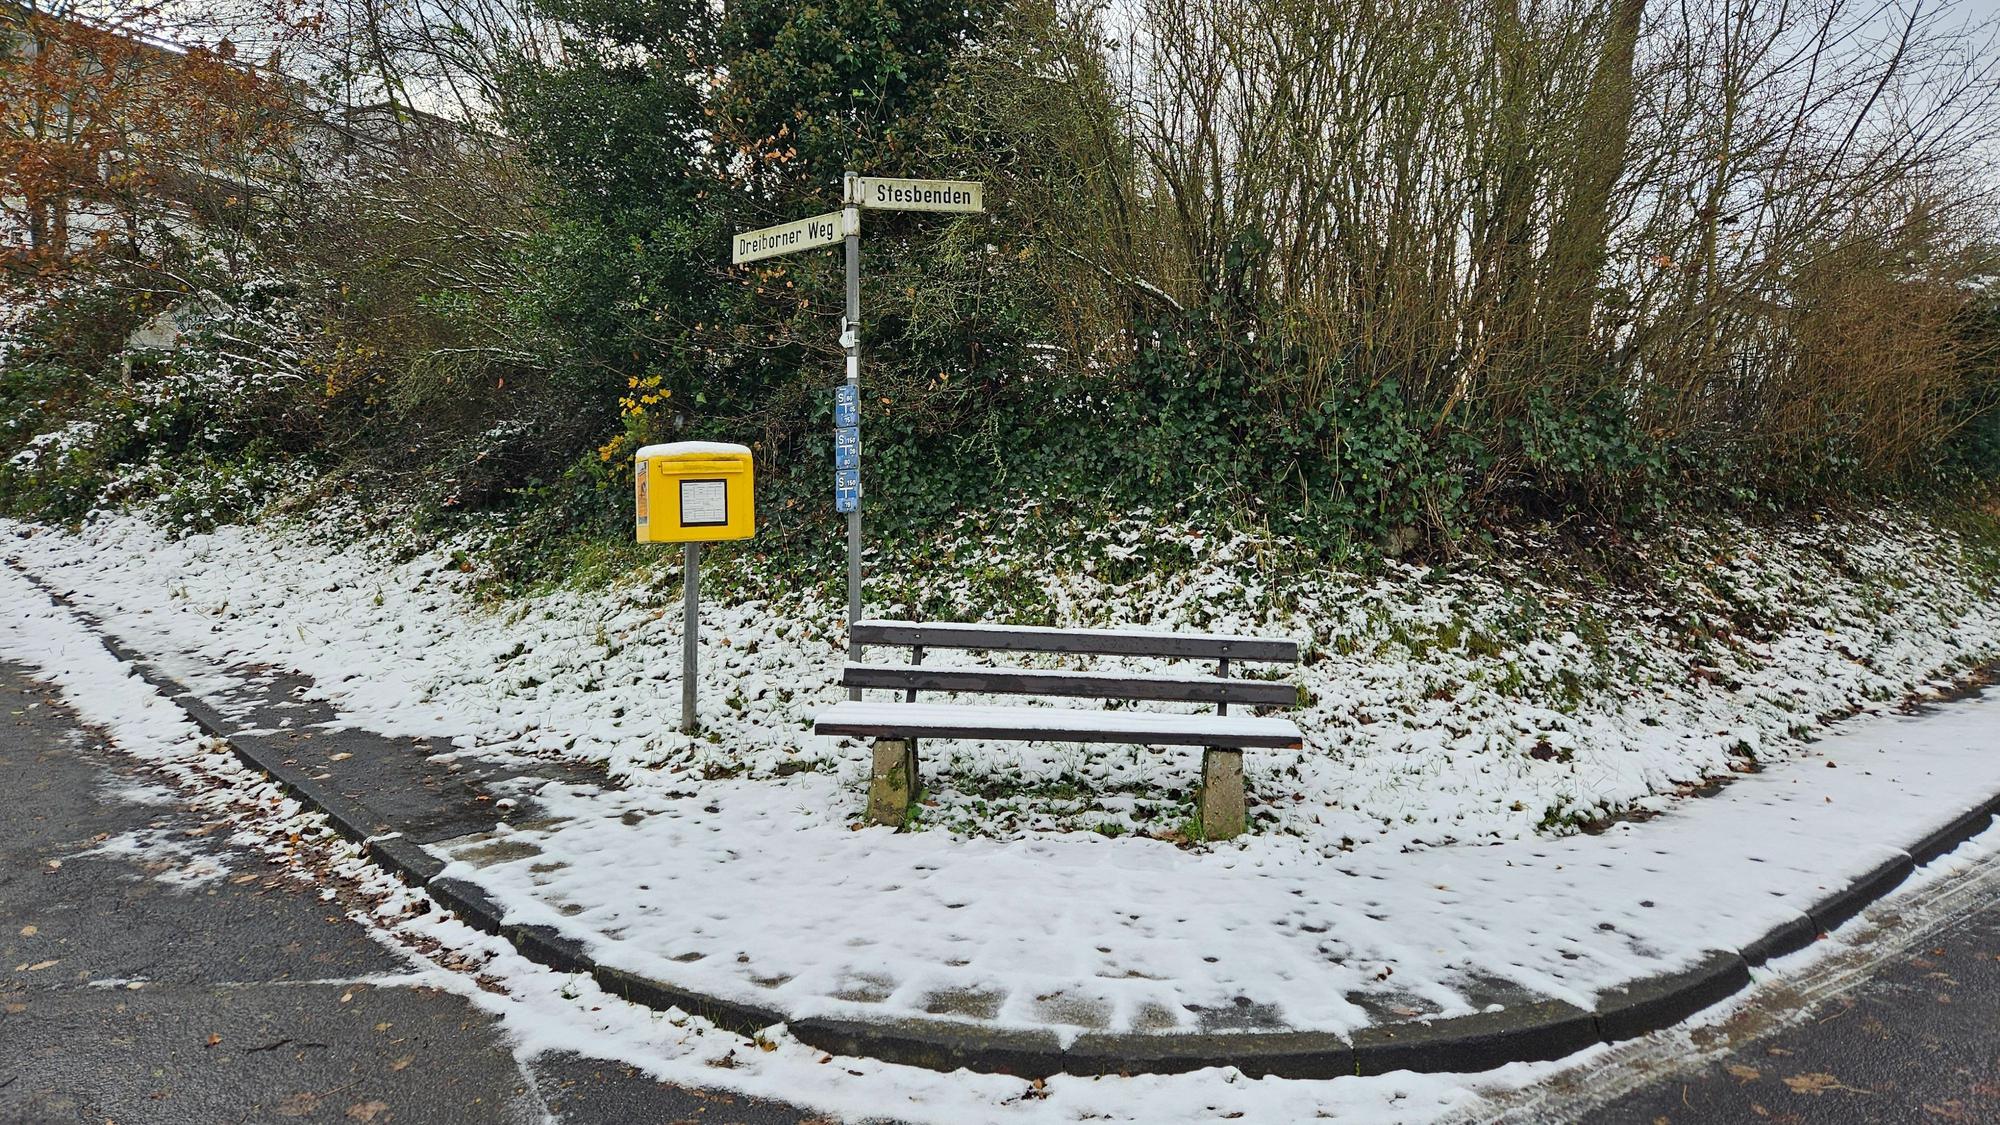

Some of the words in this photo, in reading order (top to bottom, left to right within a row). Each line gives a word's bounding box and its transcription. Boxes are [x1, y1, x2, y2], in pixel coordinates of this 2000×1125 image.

[877, 184, 971, 205] Stesbenden
[740, 229, 802, 256] Dreiborner
[808, 221, 833, 240] Weg
